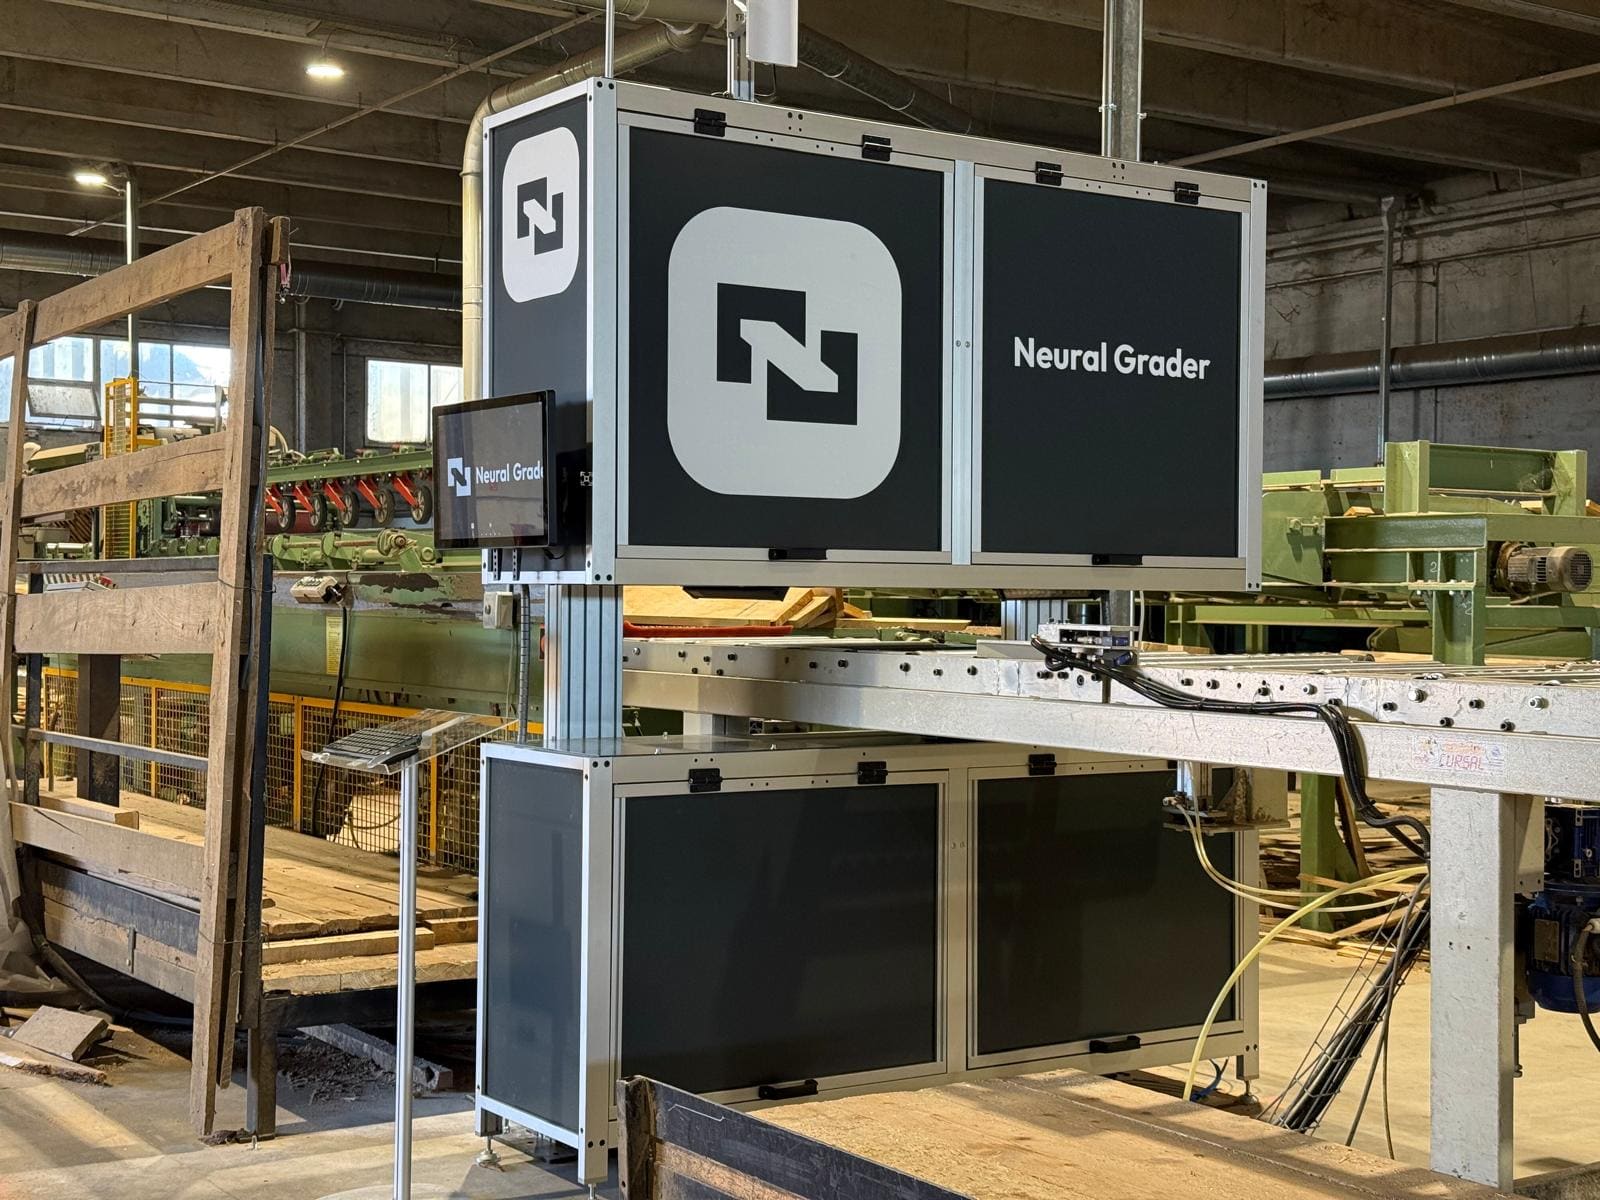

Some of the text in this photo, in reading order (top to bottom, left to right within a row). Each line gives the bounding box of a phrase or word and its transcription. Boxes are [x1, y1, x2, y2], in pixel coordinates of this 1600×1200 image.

[1014, 336, 1211, 379] Neural Grader
[475, 463, 510, 484] Neural
[1430, 561, 1438, 573] 2
